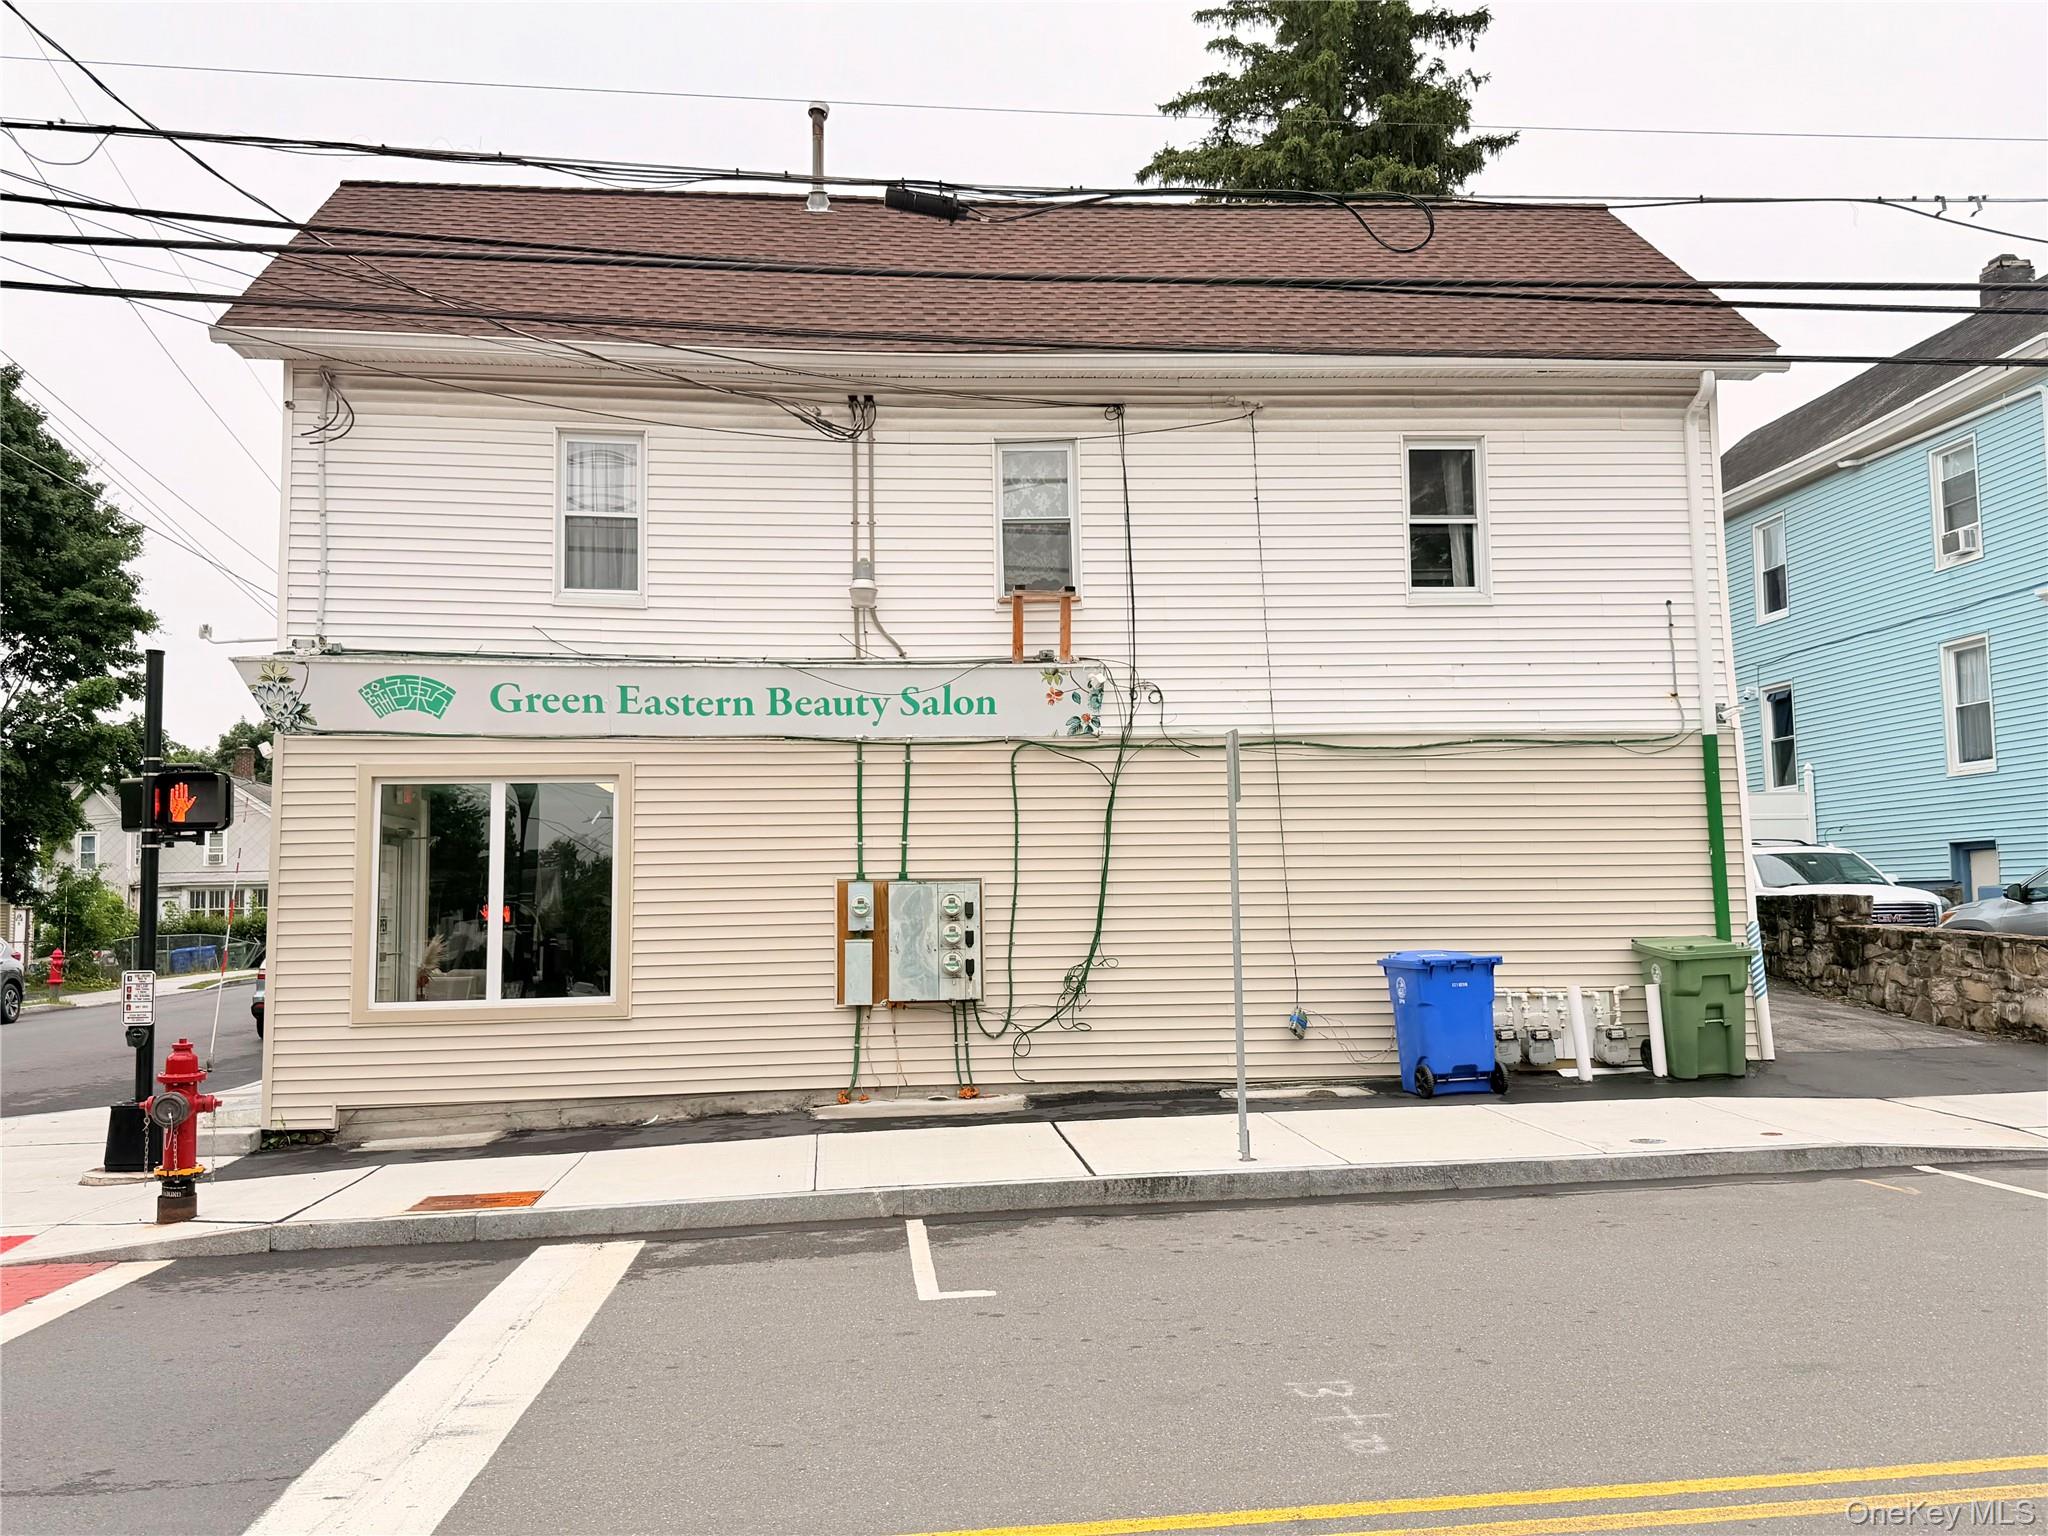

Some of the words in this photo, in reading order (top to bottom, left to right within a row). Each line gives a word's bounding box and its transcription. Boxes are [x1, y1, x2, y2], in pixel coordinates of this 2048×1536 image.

[490, 682, 605, 714] Green
[617, 685, 753, 717] Eastern
[767, 687, 892, 726] Beauty
[900, 685, 997, 715] Salon
